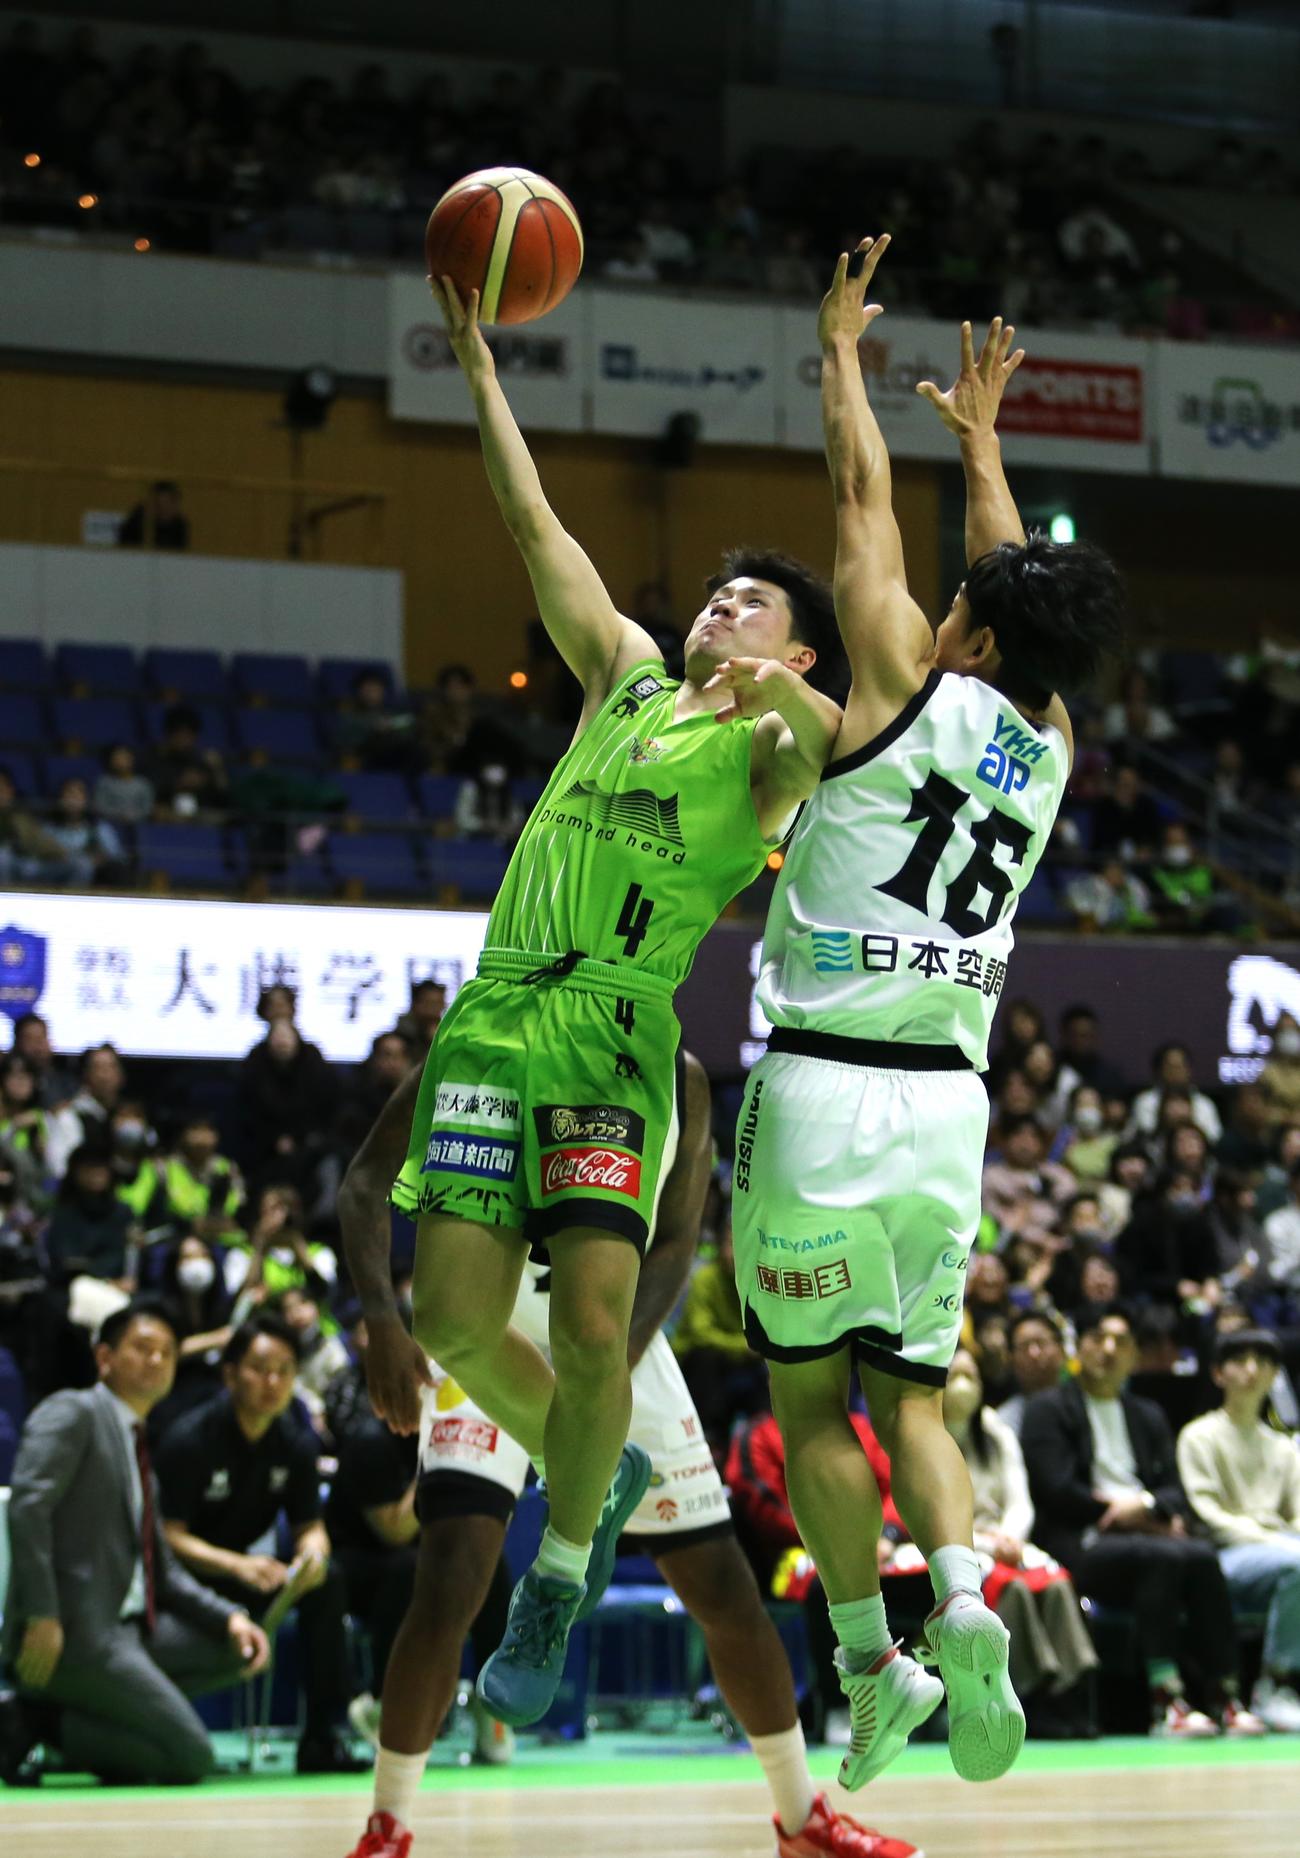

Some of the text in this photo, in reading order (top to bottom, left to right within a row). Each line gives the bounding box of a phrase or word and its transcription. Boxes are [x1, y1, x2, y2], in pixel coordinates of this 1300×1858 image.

[992, 713, 1050, 764] YKK
[539, 809, 686, 865] Diamond head
[872, 768, 1036, 939] 16
[615, 882, 654, 958] 4
[861, 935, 1007, 1000] 日本空調
[615, 996, 635, 1037] 4
[572, 1122, 628, 1138] レオファン
[757, 1228, 847, 1254] TATEYAMA
